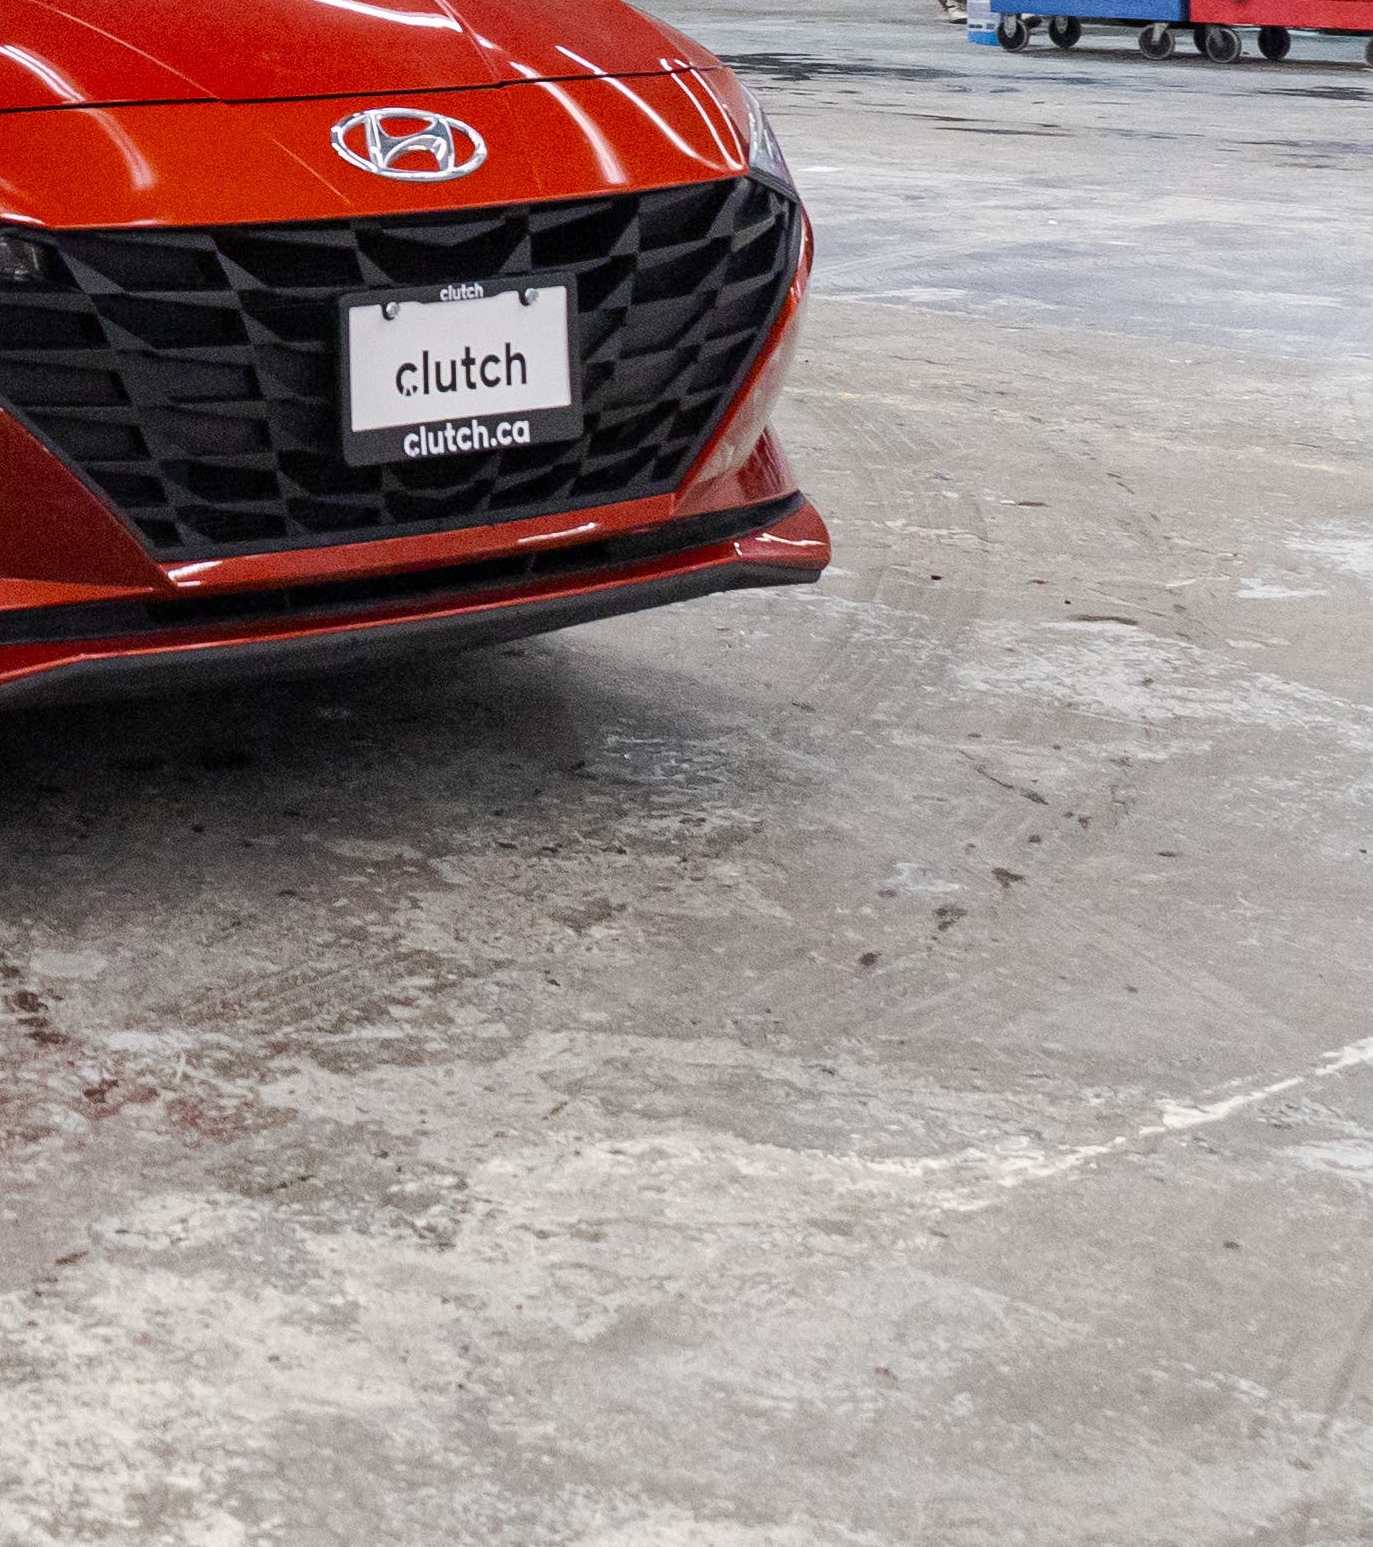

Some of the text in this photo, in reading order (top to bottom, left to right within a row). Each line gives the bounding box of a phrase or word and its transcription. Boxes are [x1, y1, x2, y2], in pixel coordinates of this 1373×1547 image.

[439, 282, 484, 301] clutch
[395, 342, 527, 397] clutch
[403, 419, 531, 458] clutch.ca
